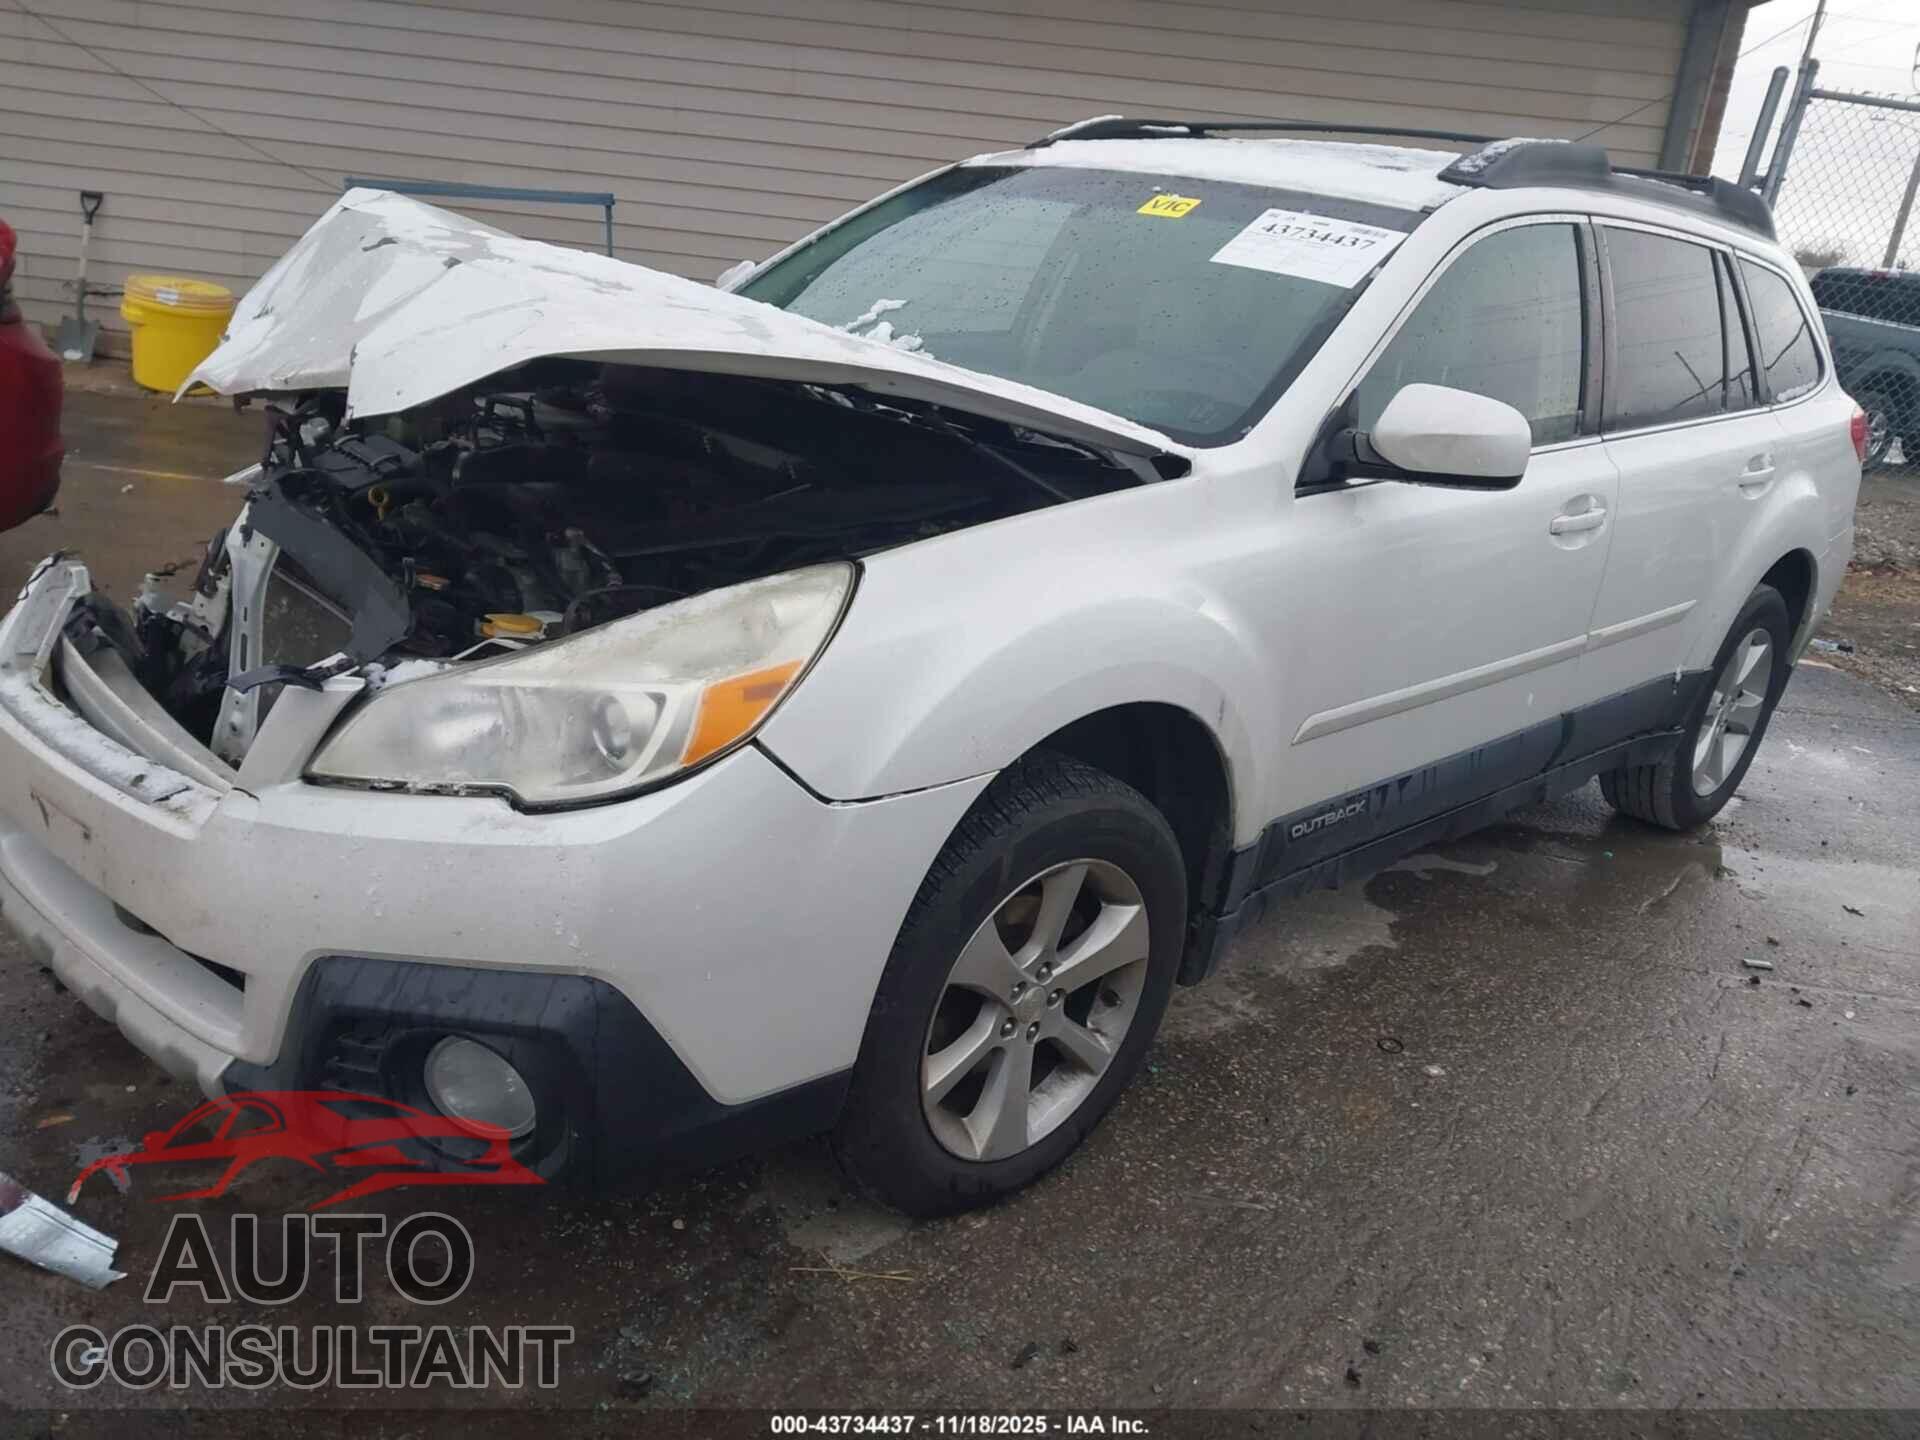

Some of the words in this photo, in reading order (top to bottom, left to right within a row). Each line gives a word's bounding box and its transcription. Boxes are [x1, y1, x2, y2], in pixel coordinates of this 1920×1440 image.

[1149, 199, 1191, 213] VIC
[1262, 223, 1376, 250] 43734437
[1291, 799, 1366, 838] OUTBACK
